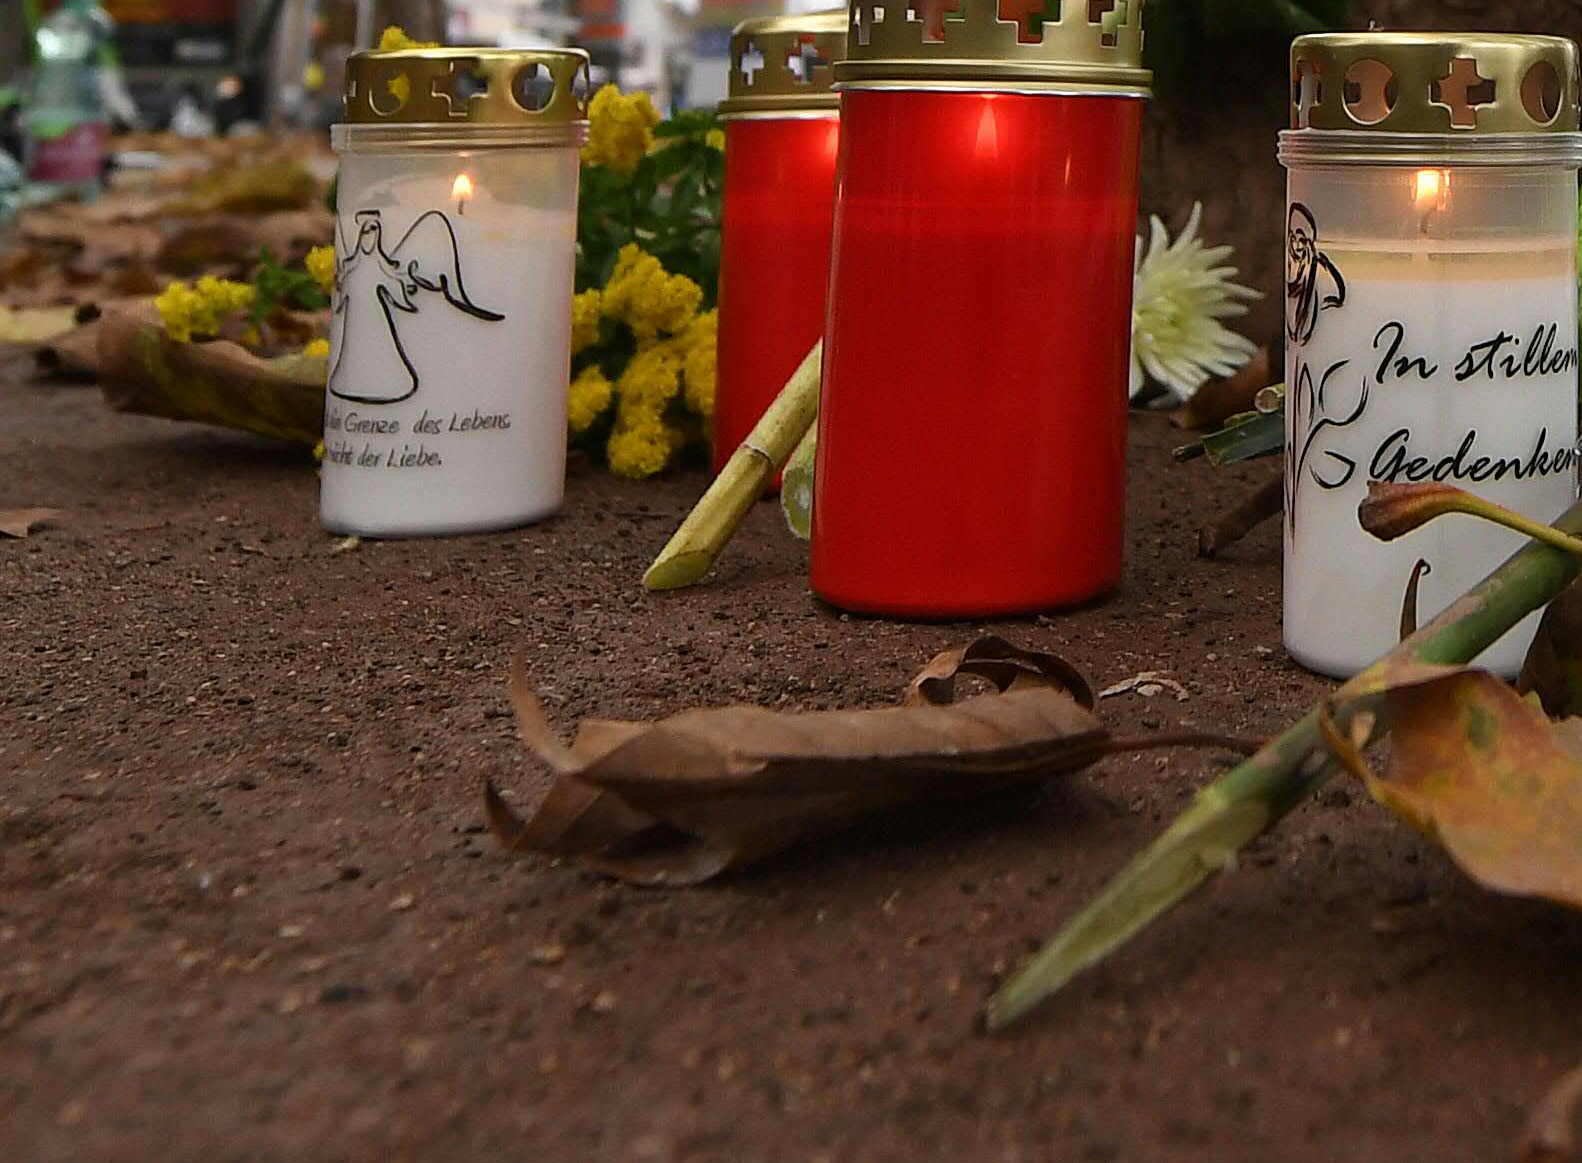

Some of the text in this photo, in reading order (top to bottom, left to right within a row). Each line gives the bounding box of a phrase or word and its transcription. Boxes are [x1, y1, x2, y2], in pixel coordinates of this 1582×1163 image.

[1373, 321, 1438, 384] In
[344, 412, 400, 434] Grenze
[412, 408, 443, 435] des
[357, 443, 381, 467] der
[386, 444, 442, 468] Liebe.
[1369, 428, 1577, 483] Gedenken
